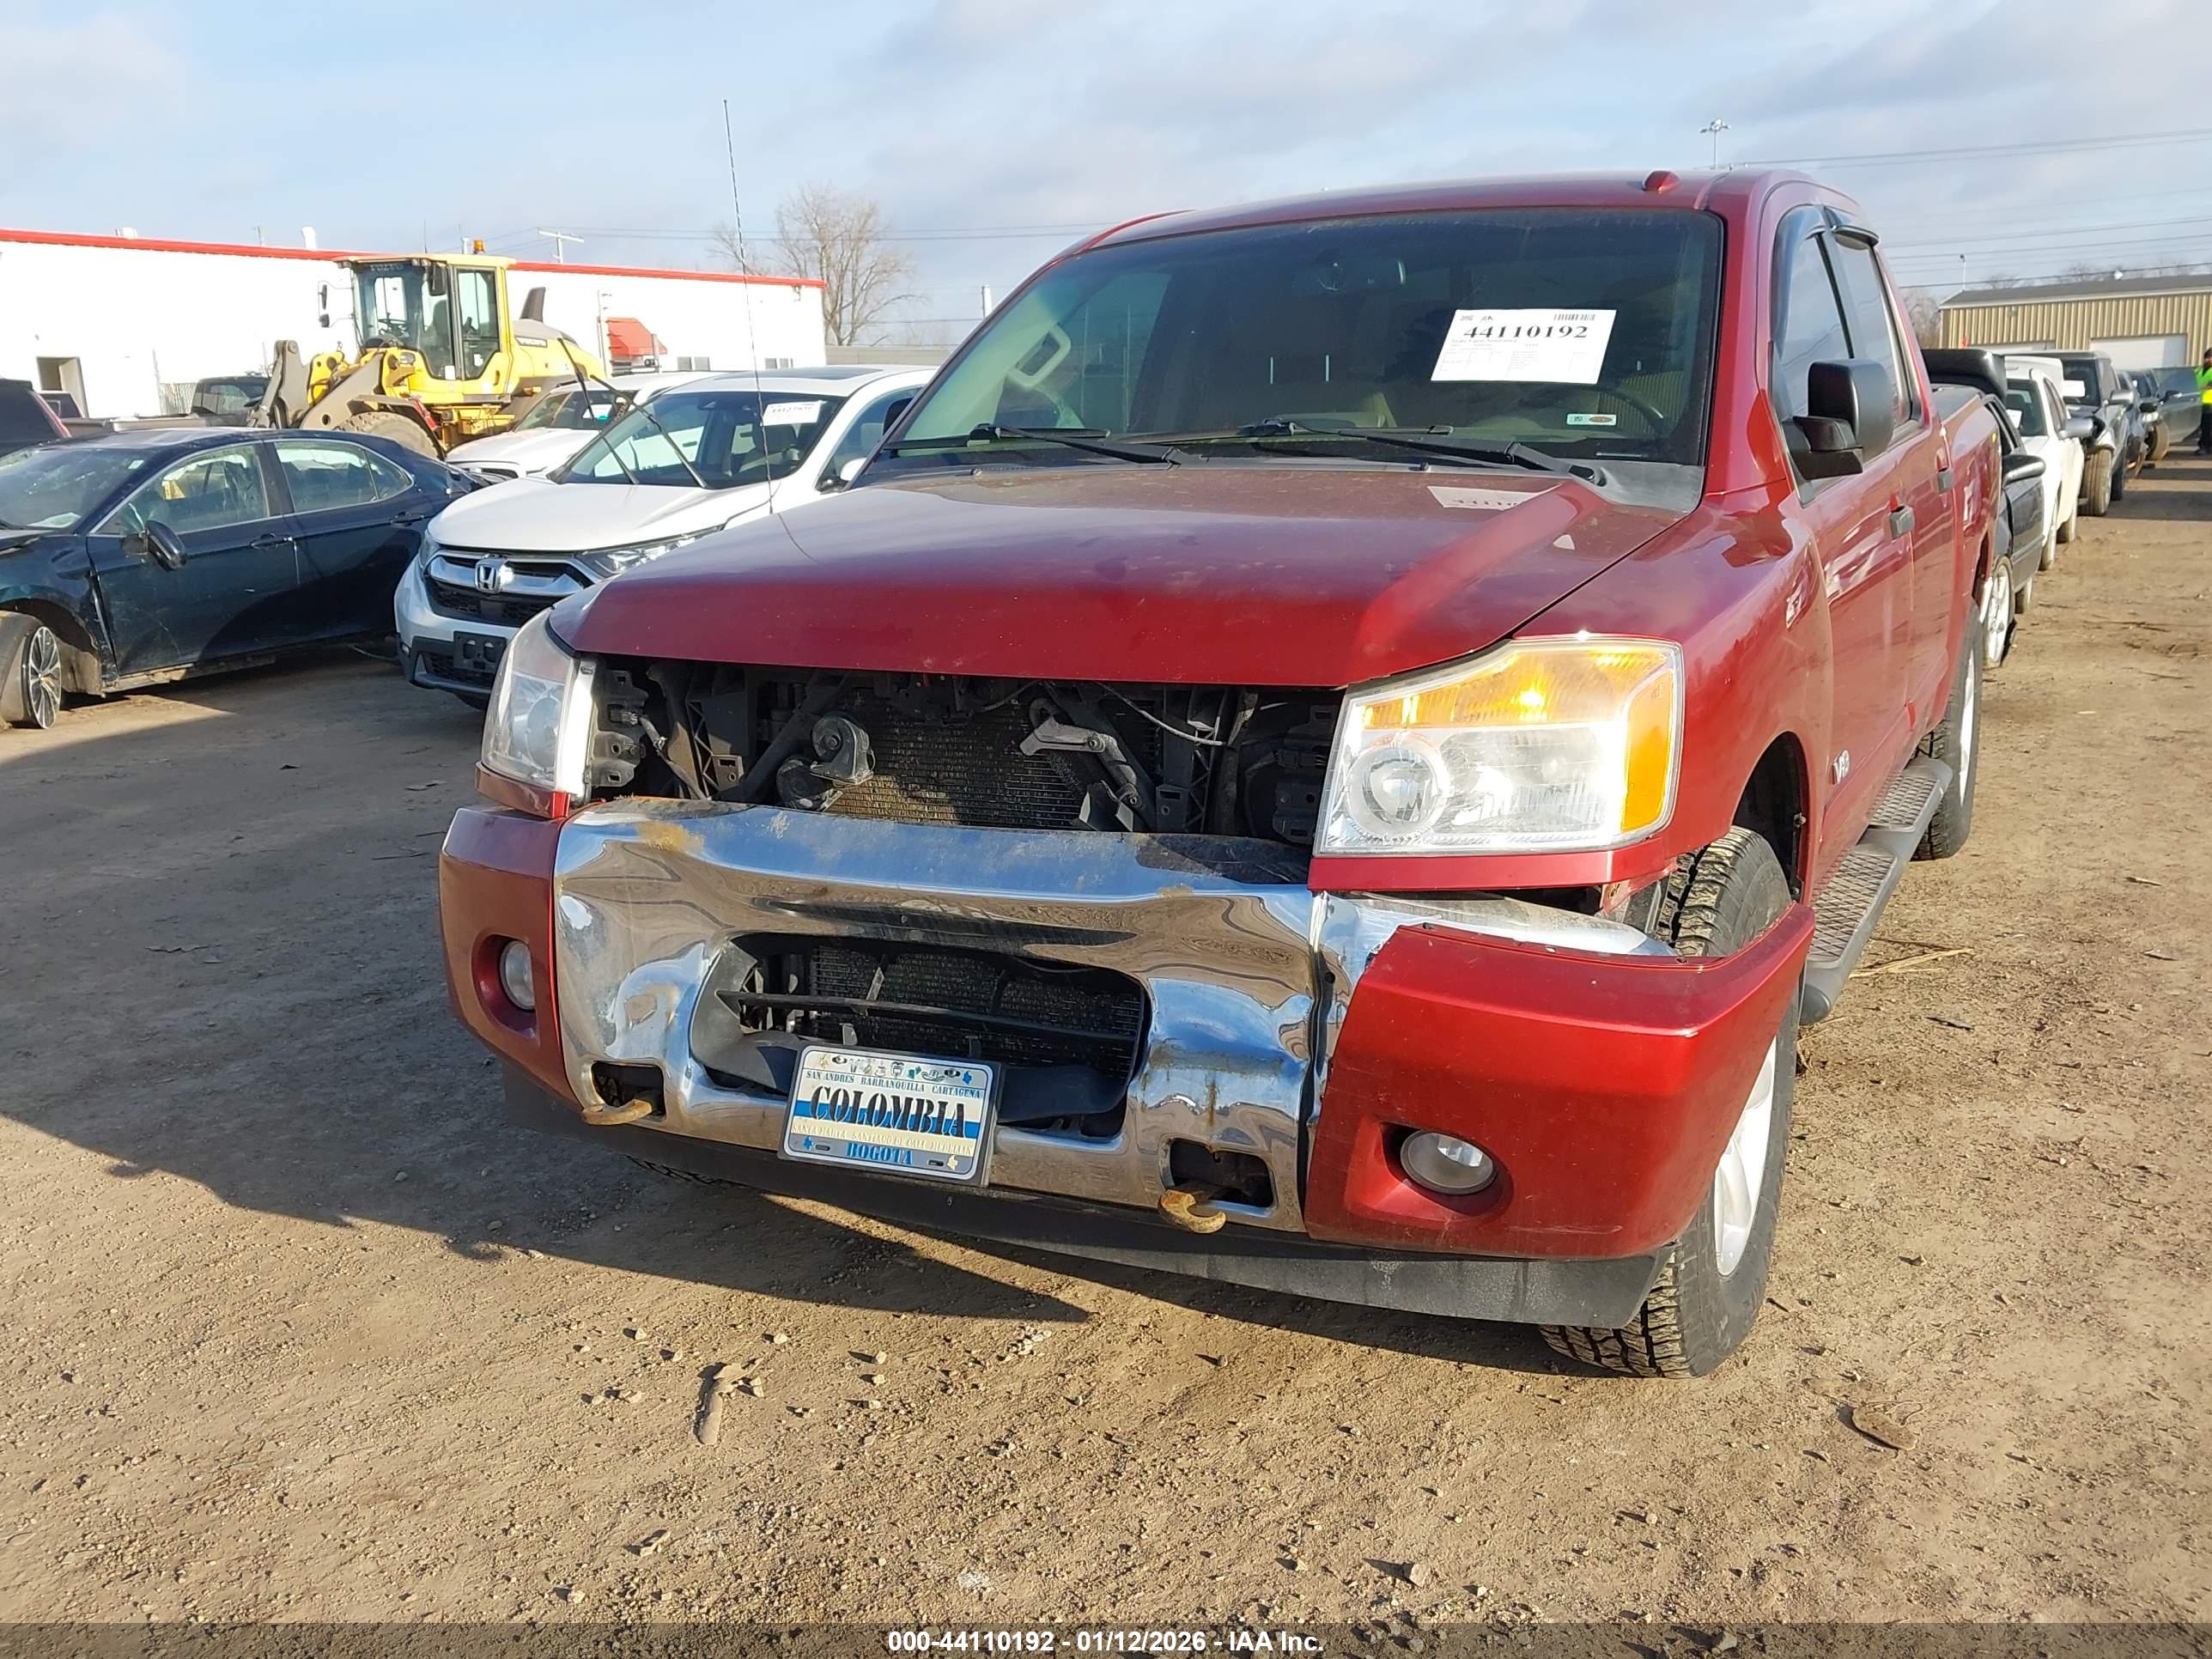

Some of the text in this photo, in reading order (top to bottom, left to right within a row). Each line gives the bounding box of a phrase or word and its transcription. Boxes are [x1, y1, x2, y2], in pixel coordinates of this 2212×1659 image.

[1463, 325, 1588, 338] 44110192
[806, 1070, 981, 1099] SAN ANDRES BARRANQUILLA CARTAGENA
[810, 1085, 966, 1139] COLOMBIA
[846, 1142, 914, 1165] BOGOTA
